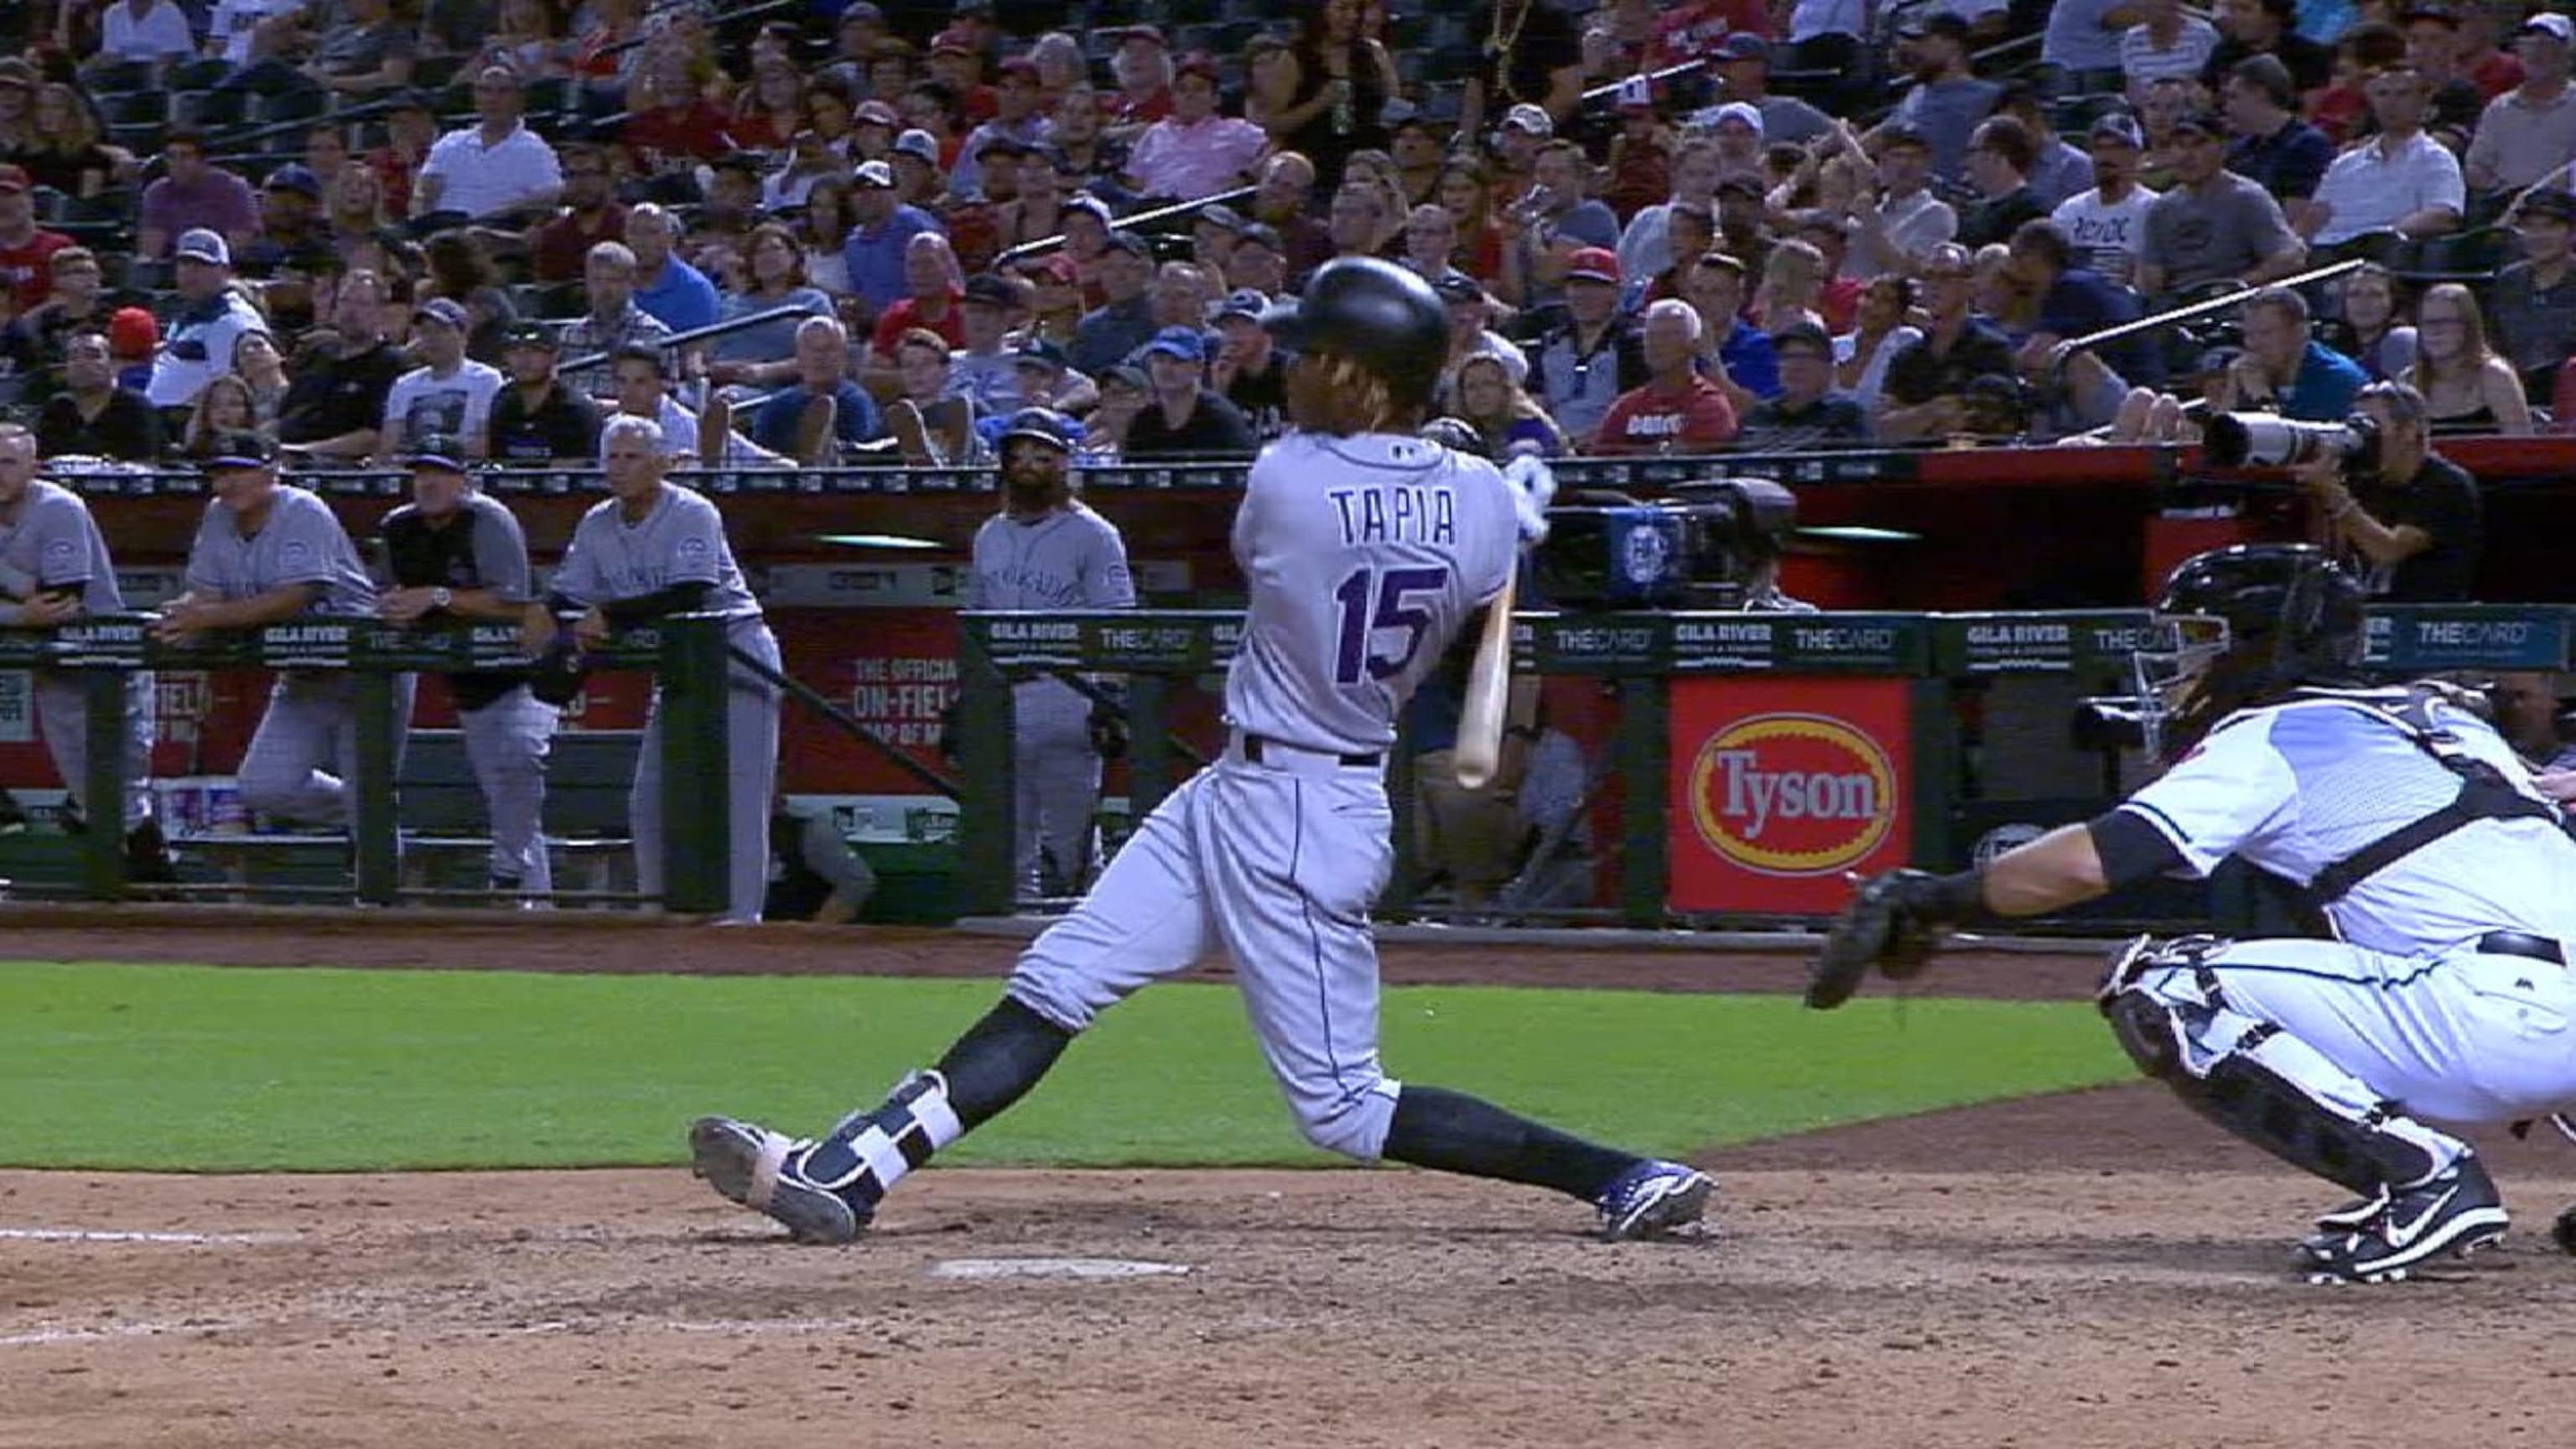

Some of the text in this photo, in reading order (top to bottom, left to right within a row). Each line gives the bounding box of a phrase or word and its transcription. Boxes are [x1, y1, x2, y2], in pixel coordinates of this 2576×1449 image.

[1327, 486, 1456, 546] TAPIA
[991, 623, 1079, 639] GILA RIVER
[1334, 564, 1450, 685] 15
[1676, 625, 1771, 640] GILA RIVER
[1968, 626, 2069, 642] GILA RIVER
[1717, 750, 1875, 839] Tyson
